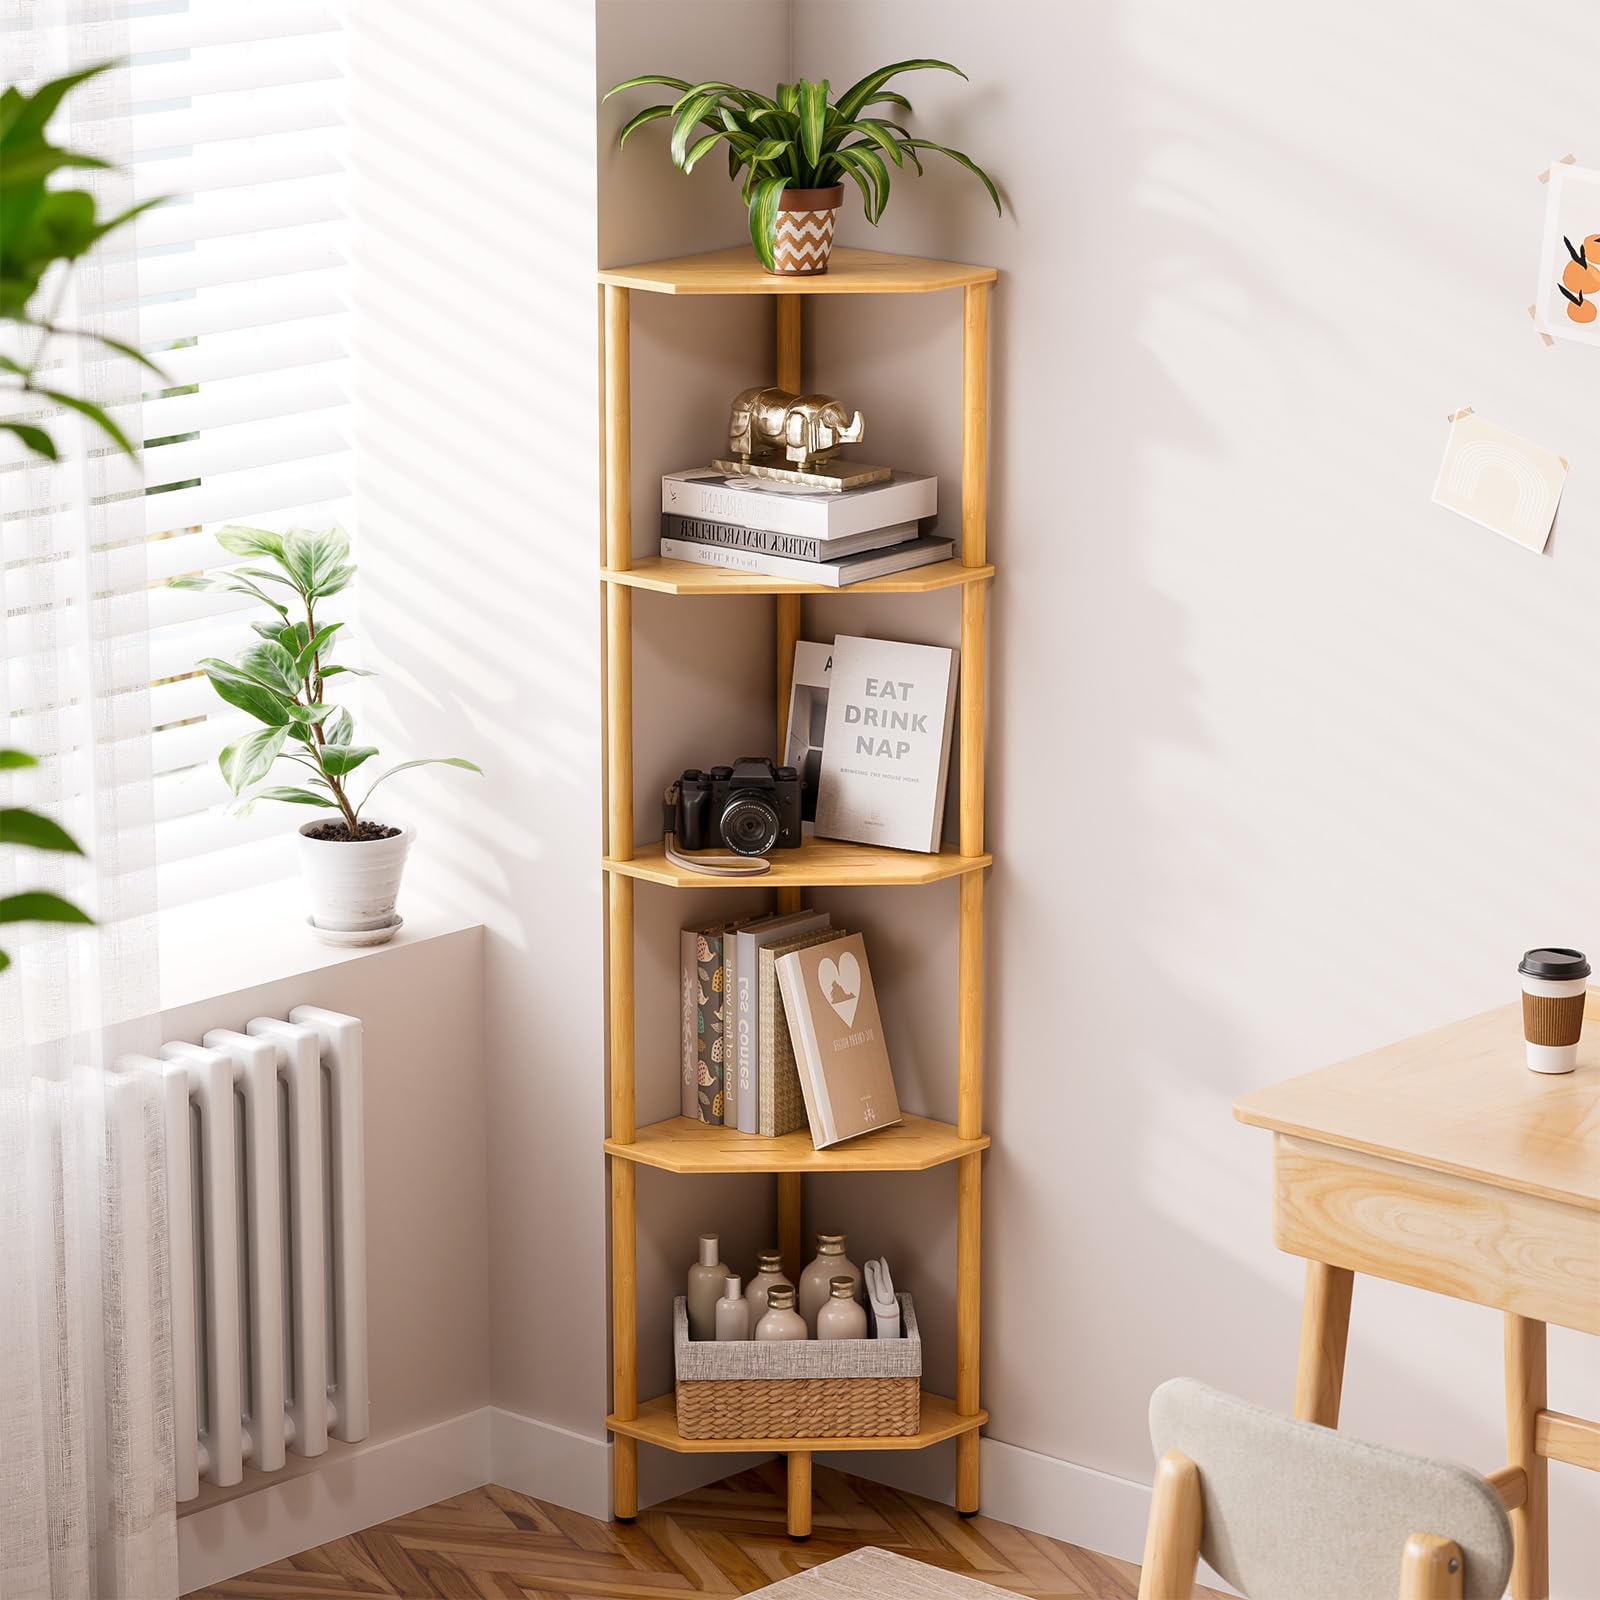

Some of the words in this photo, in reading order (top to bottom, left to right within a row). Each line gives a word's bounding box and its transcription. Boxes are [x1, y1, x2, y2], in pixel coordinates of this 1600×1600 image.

[865, 678, 914, 702] EAT
[844, 704, 928, 733] DRINK
[855, 735, 911, 760] NAP
